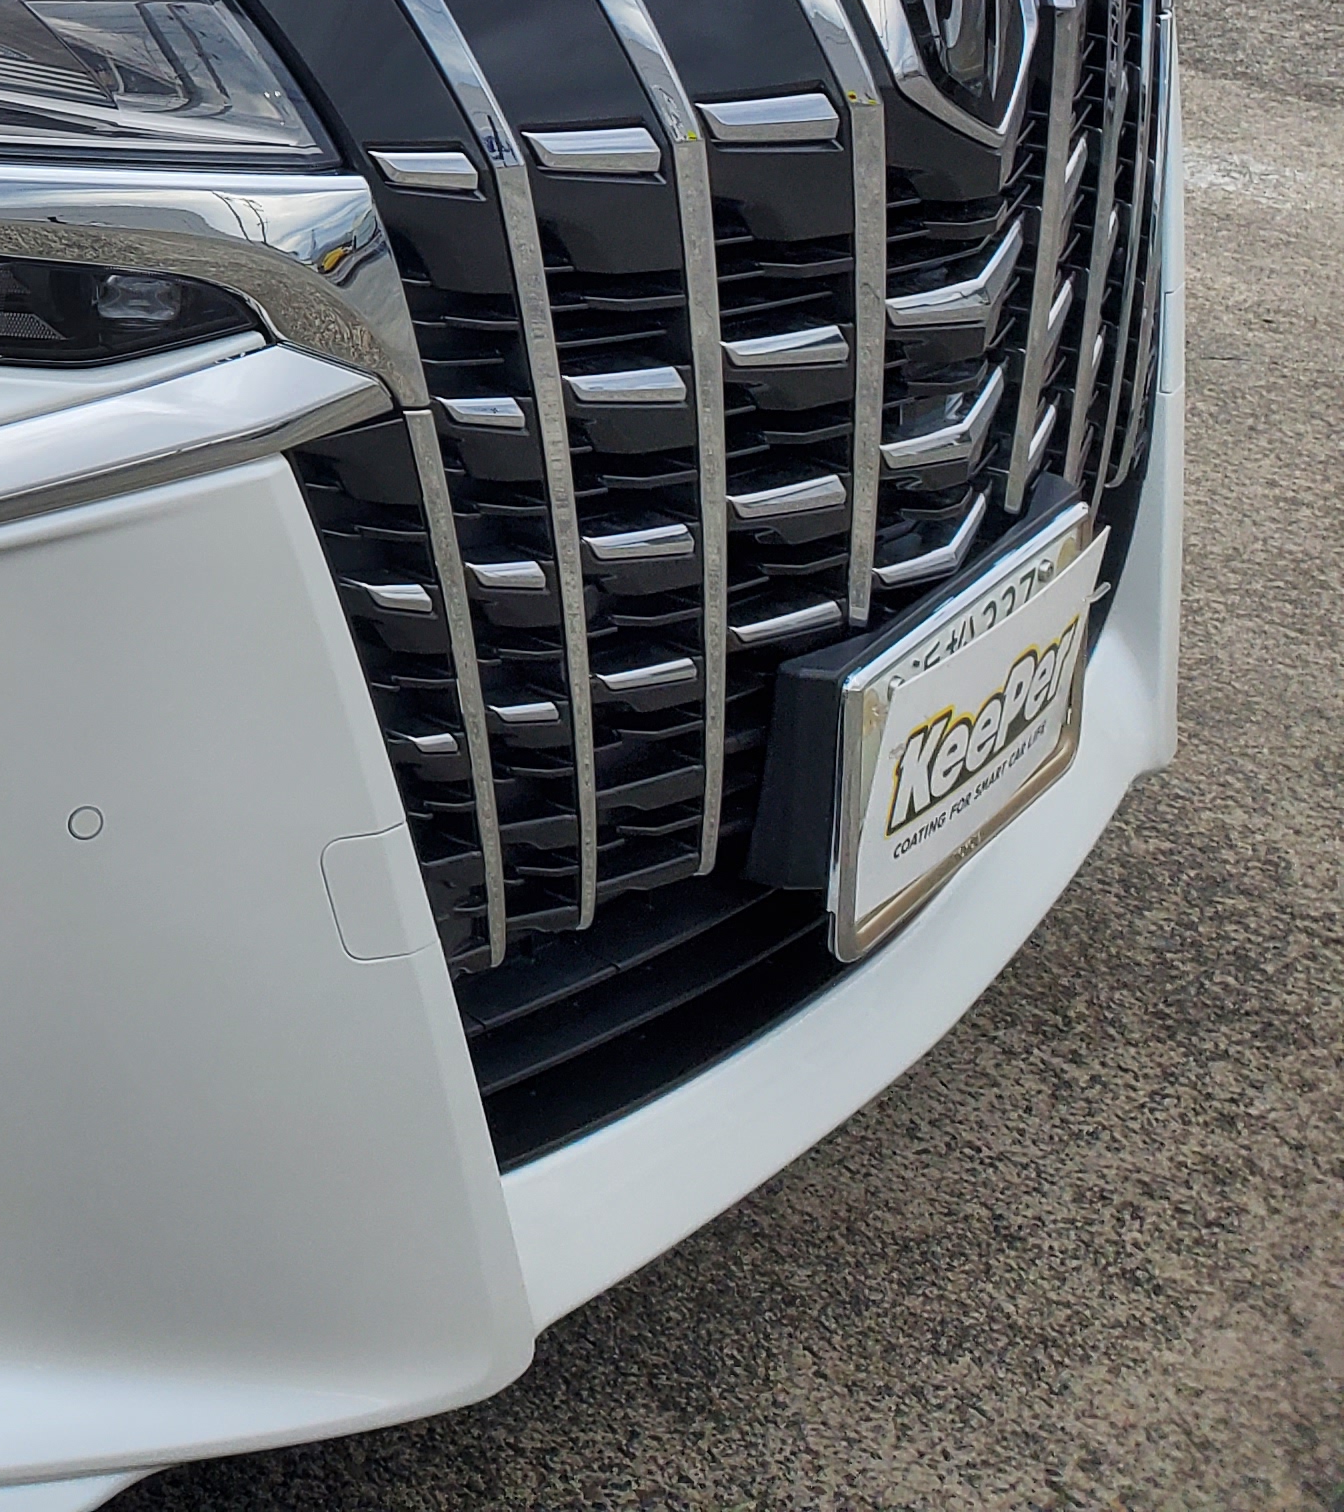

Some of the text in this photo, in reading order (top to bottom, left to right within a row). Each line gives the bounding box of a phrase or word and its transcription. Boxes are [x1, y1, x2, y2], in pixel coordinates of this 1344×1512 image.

[883, 614, 1080, 838] KeePer
[893, 811, 946, 859] COATING
[949, 792, 972, 820] FOR
[974, 760, 1007, 800] SMART
[1008, 742, 1026, 769] CAR
